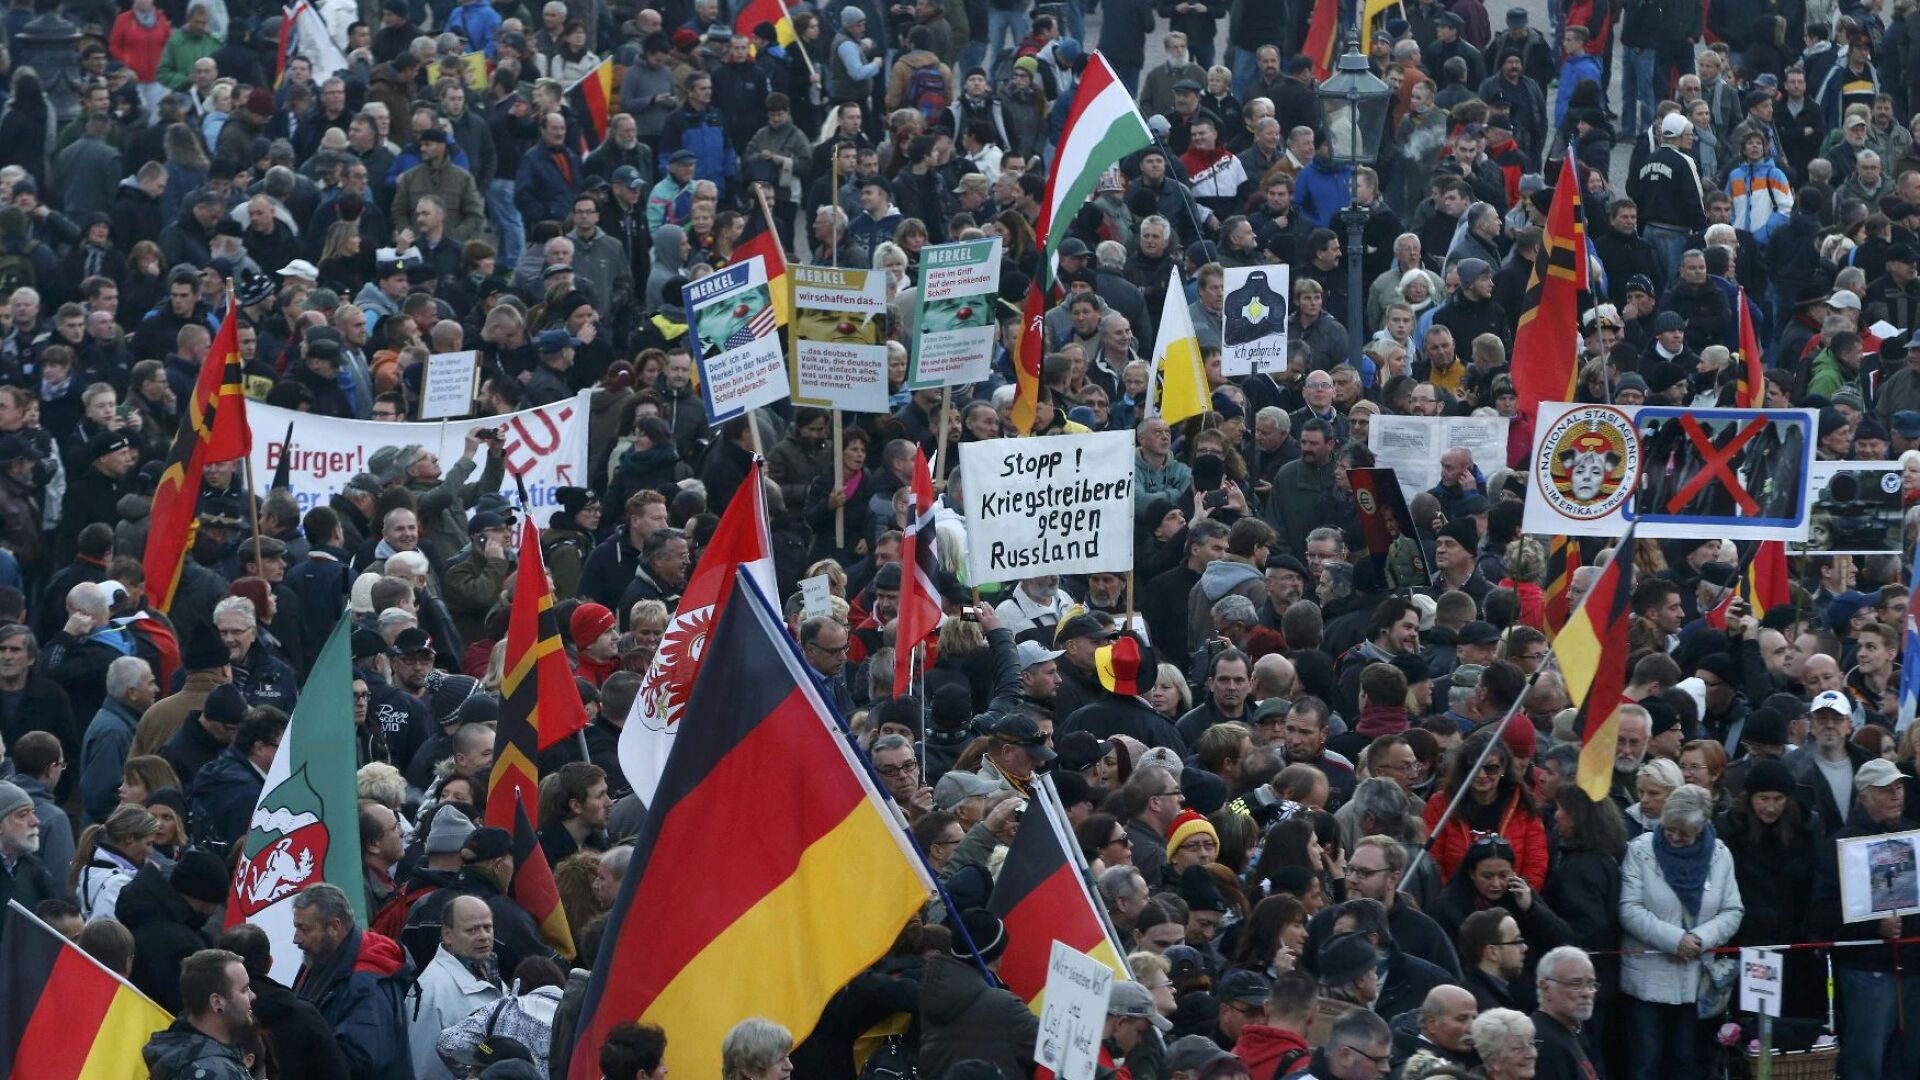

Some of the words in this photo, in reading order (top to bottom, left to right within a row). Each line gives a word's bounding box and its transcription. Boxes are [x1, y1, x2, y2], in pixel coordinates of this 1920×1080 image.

[928, 248, 972, 264] MERKEL
[795, 268, 846, 285] MERKEL
[927, 280, 940, 289] auf
[941, 278, 956, 287] dem
[957, 274, 991, 285] sinkenden
[929, 270, 945, 279] alles
[957, 267, 973, 277] Griff
[689, 273, 735, 301] MERKEL
[927, 288, 951, 298] Schiff?
[800, 292, 814, 301] wir
[815, 293, 857, 304] schaffen
[857, 296, 883, 305] das...
[729, 354, 740, 365] ich
[741, 351, 750, 361] an
[823, 349, 858, 358] deutsche
[1234, 346, 1246, 359] ich
[1246, 342, 1281, 360] gehorche
[711, 367, 734, 383] Merkel
[735, 365, 743, 374] in
[744, 360, 754, 371] der
[756, 351, 777, 366] Nacht,
[801, 355, 817, 363] Volk
[819, 356, 829, 365] ab,
[846, 359, 881, 368] deutsche
[801, 363, 827, 373] Kultur,
[828, 365, 857, 375] einfach
[859, 367, 880, 376] alles,
[713, 379, 732, 393] Dann
[732, 376, 744, 388] bin
[744, 371, 755, 382] ich
[756, 367, 767, 376] um
[767, 360, 781, 372] den
[801, 379, 818, 387] land
[820, 380, 853, 389] erinnert.
[845, 374, 881, 383] Deutsch-
[714, 388, 736, 404] Schlaf
[736, 377, 768, 396] gebracht.
[1584, 410, 1619, 423] STASI
[1541, 414, 1581, 470] NATIONAL
[1617, 423, 1637, 473] AGENCY
[266, 442, 364, 478] Bürger!
[1000, 451, 1062, 479] Stopp
[981, 471, 1133, 519] Kriegstreiberei
[1602, 485, 1628, 510] TRUST
[1038, 508, 1100, 538] gegen
[990, 531, 1099, 570] Russland
